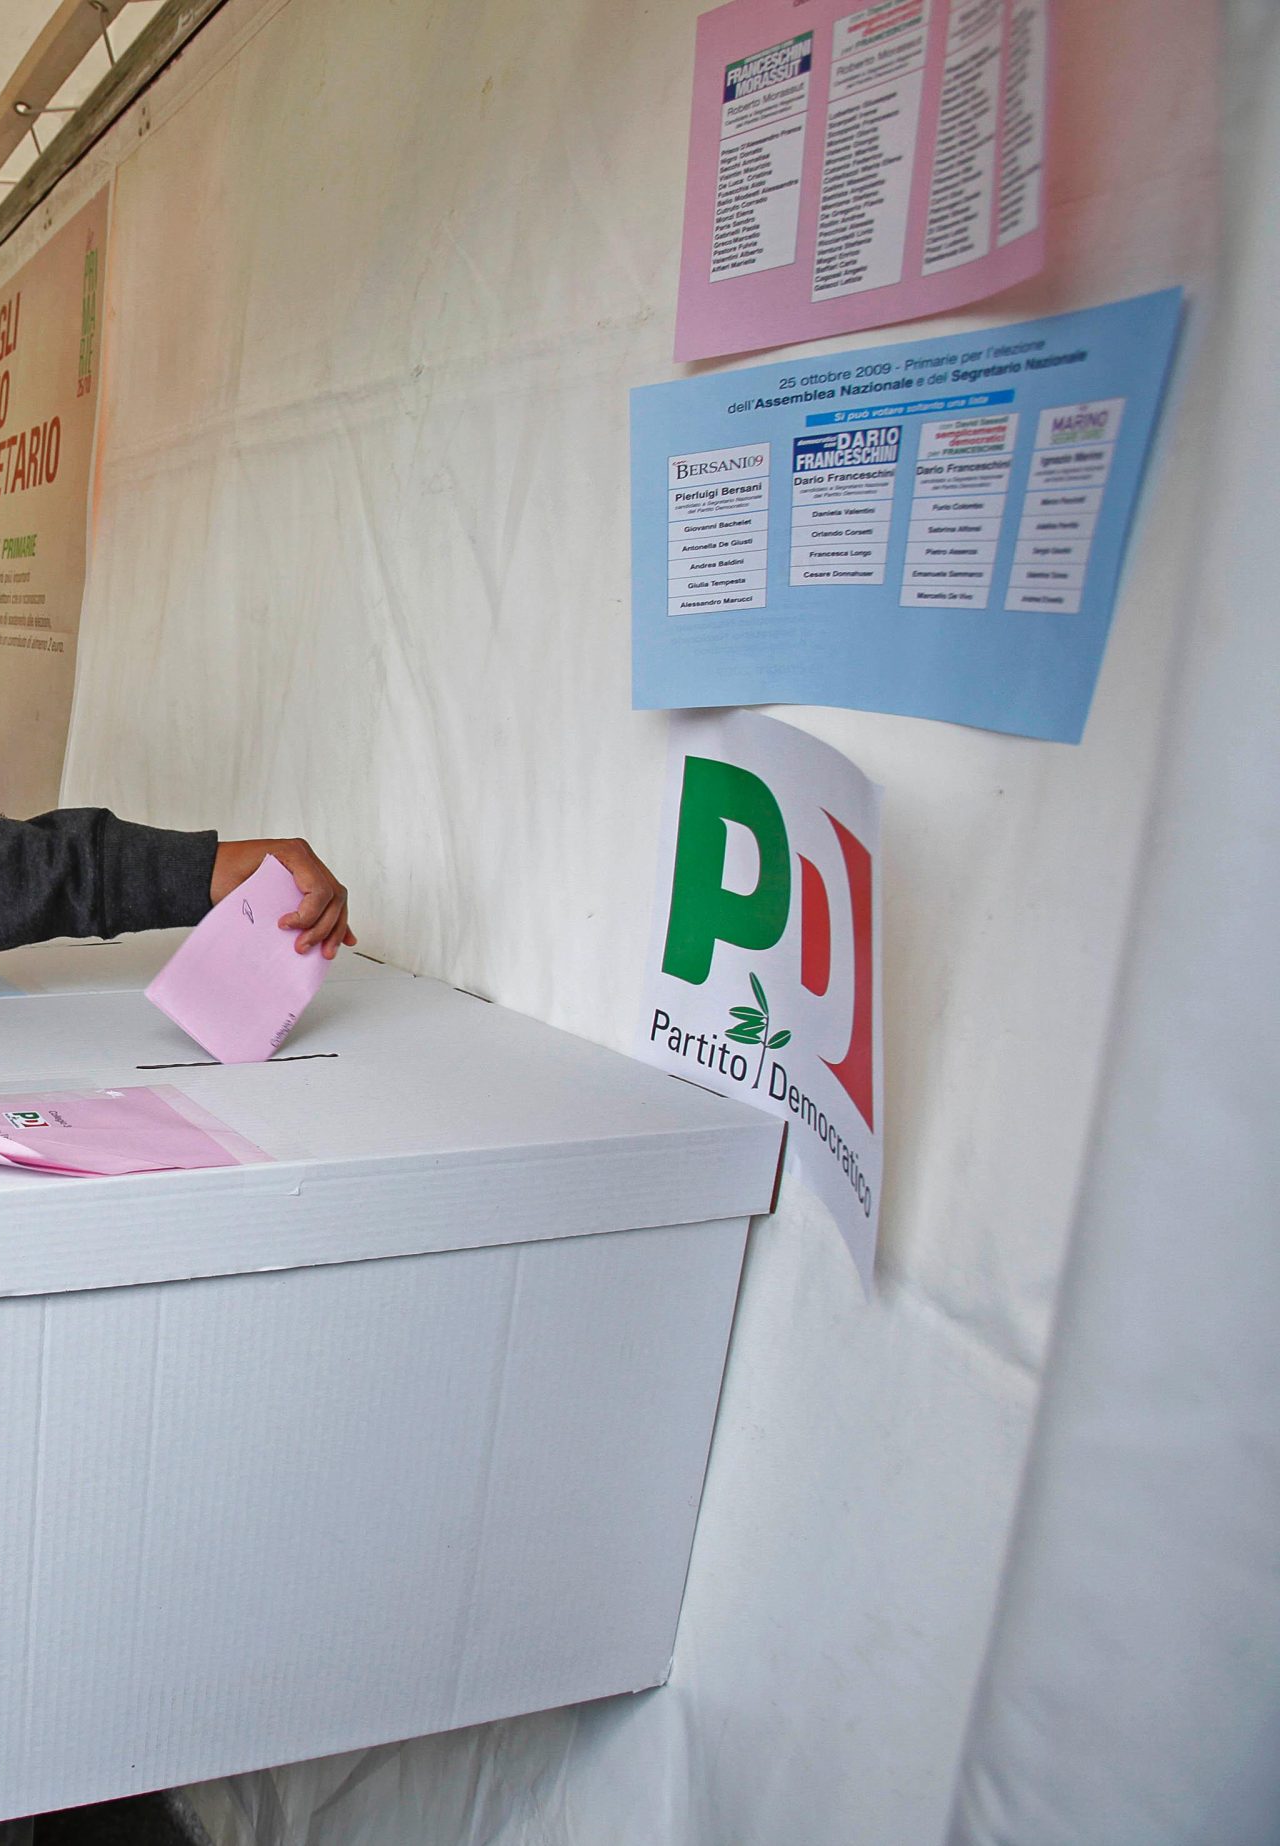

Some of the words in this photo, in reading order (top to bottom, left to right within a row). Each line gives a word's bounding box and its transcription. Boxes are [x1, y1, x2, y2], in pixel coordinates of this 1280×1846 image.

[726, 39, 810, 85] FRANCESCHINI
[735, 59, 800, 97] MORASSUT
[727, 97, 760, 116] Roberto
[778, 377, 796, 390] 25
[800, 370, 852, 388] ottobre
[856, 364, 891, 379] 2009
[905, 354, 958, 372] Primarie
[960, 351, 983, 367] per
[986, 340, 1046, 360] l'elezione
[728, 388, 835, 415] dell'Assemblea
[840, 378, 913, 398] Nazionale
[916, 378, 924, 386] e
[952, 362, 1021, 385] Segretario
[1024, 350, 1088, 372] Nazionale
[1051, 410, 1109, 431] MARINO
[837, 426, 899, 449] DARIO
[677, 453, 763, 479] BERSANI09
[796, 444, 897, 470] FRANCESCHINI
[916, 465, 943, 475] Dario
[946, 460, 1010, 472] Franceschini
[794, 475, 823, 485] Dario
[827, 468, 894, 482] Franceschini
[675, 488, 718, 503] Pierluigi
[721, 482, 761, 495] Bersani
[683, 522, 716, 532] Giovanni
[719, 518, 751, 528] Bachelet
[2, 534, 37, 559] PRIMARIE
[682, 542, 716, 552] Antonella
[730, 538, 752, 546] Giusti
[690, 561, 715, 569] Andrea
[718, 558, 744, 566] Baldini
[711, 577, 745, 587] Tempesta
[680, 599, 721, 608] Alessandro
[52, 640, 64, 652] euro.
[661, 755, 874, 1134] PD
[650, 1008, 748, 1081] Partito
[768, 1061, 872, 1219] Democratico
